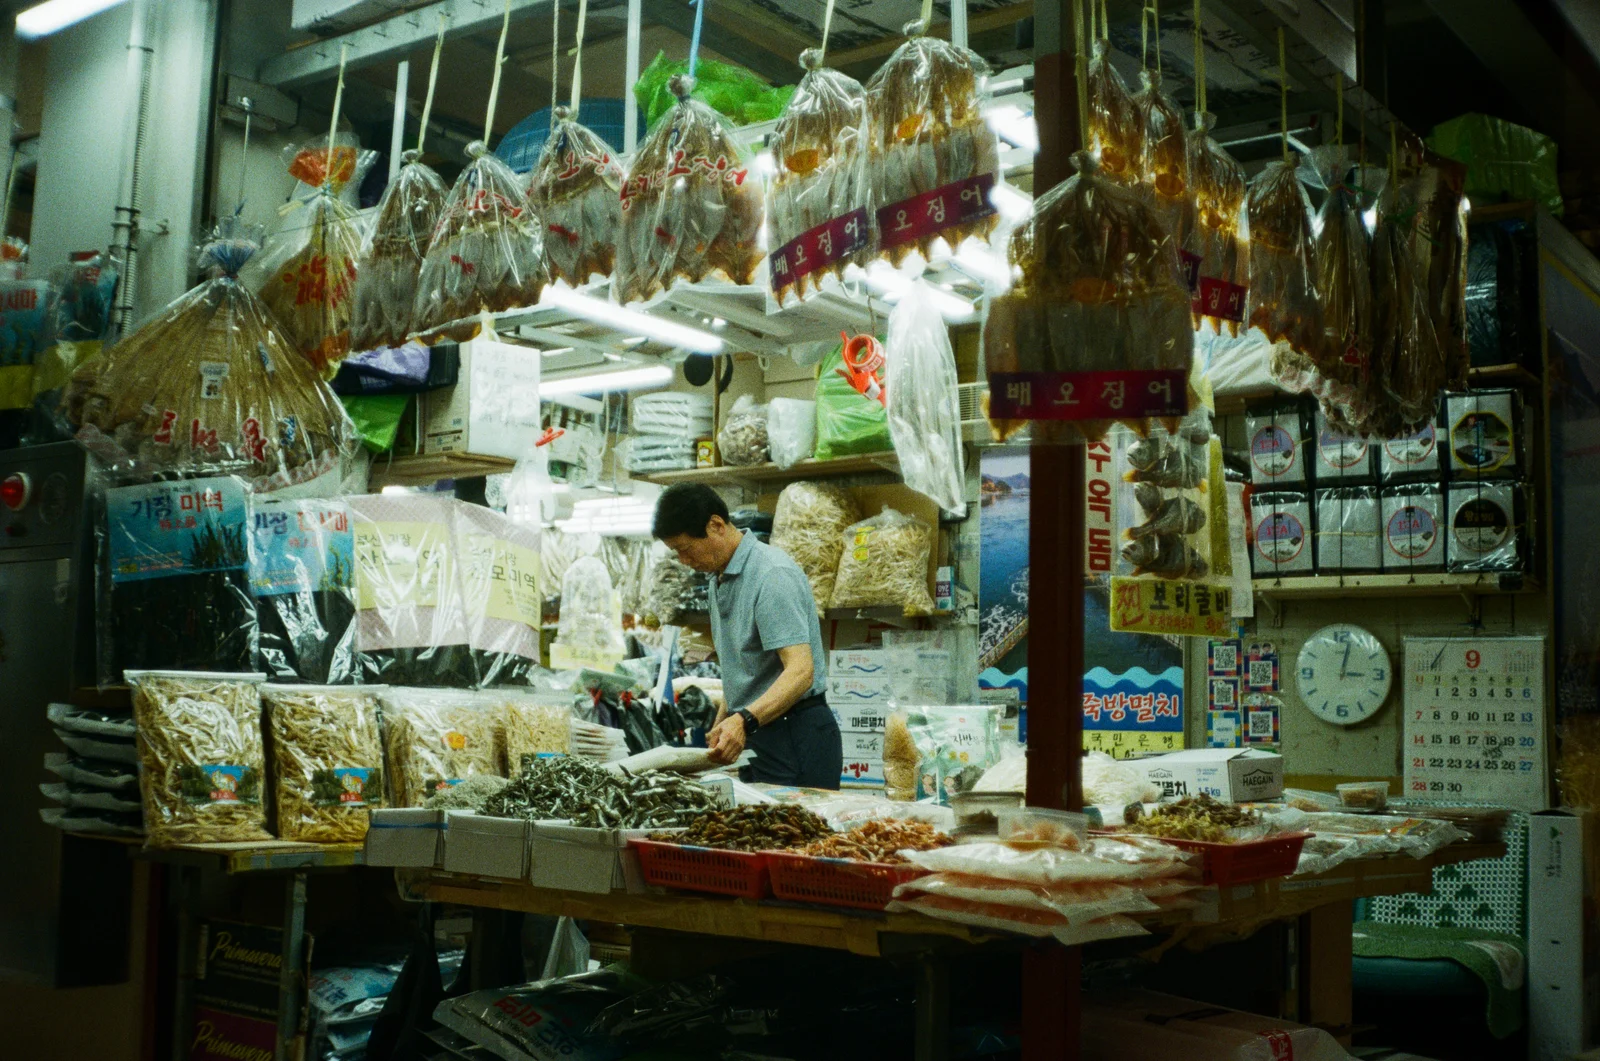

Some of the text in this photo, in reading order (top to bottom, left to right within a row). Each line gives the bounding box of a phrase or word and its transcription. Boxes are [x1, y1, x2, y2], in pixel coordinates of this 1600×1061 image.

[774, 216, 859, 275] 배오징어
[1007, 379, 1172, 410] 배오징어
[131, 490, 223, 520] 기장 미역
[1150, 582, 1229, 616] 보리굴비
[1334, 631, 1350, 642] 12
[1465, 650, 1481, 668] 9
[1302, 668, 1384, 680] 9 3
[1435, 688, 1531, 698] 1 2 3 4 5 6
[1082, 692, 1178, 722] 죽방멸치
[1337, 705, 1348, 716] 6
[1416, 711, 1532, 722] 7 8 9 10 11 12 13
[1413, 735, 1424, 744] 14
[1431, 735, 1442, 744] 15
[1467, 736, 1479, 745] 17
[1519, 737, 1534, 747] 20
[1413, 758, 1532, 771] 21 22 23 24 25 26 27
[1242, 776, 1275, 787] HAEGAIN
[1412, 782, 1462, 793] 28 29 30
[208, 930, 283, 968] Primavera
